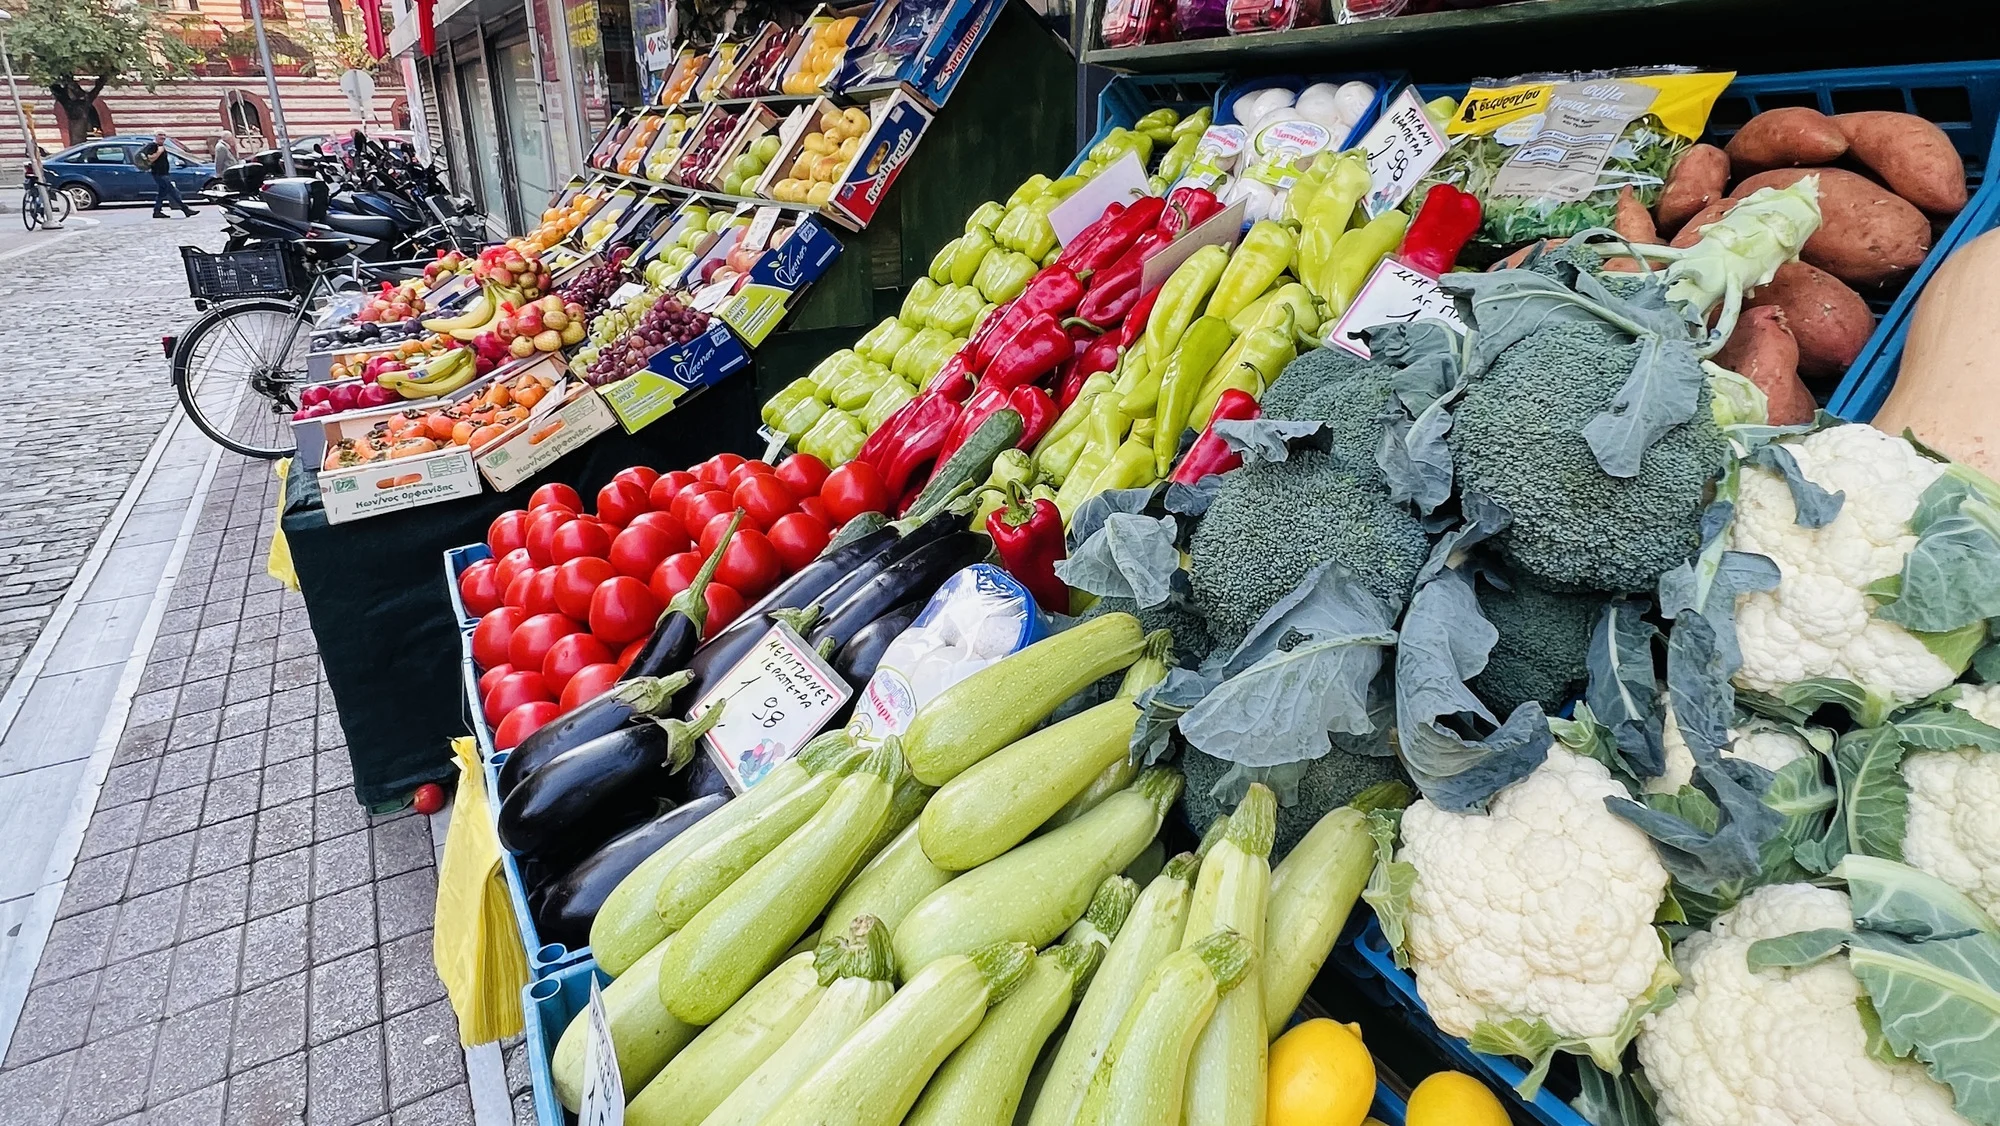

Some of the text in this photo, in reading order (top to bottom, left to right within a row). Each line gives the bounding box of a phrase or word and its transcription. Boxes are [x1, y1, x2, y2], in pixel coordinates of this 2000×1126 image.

[943, 22, 982, 76] Sarantidis
[1391, 112, 1423, 157] ΙΕΡΑΠΕΤΡΑ
[1405, 107, 1434, 146] ΤΗΓΑΝΗ
[1387, 149, 1409, 181] 98
[356, 495, 399, 509] Κων/νος
[401, 484, 454, 500] Ορφανίδης
[761, 657, 812, 709] ΙΕΡΑΠΕΤΡΑ
[765, 639, 834, 707] ΜΕΛΙΤΖΑΝΕΣ
[752, 697, 785, 728] 98
